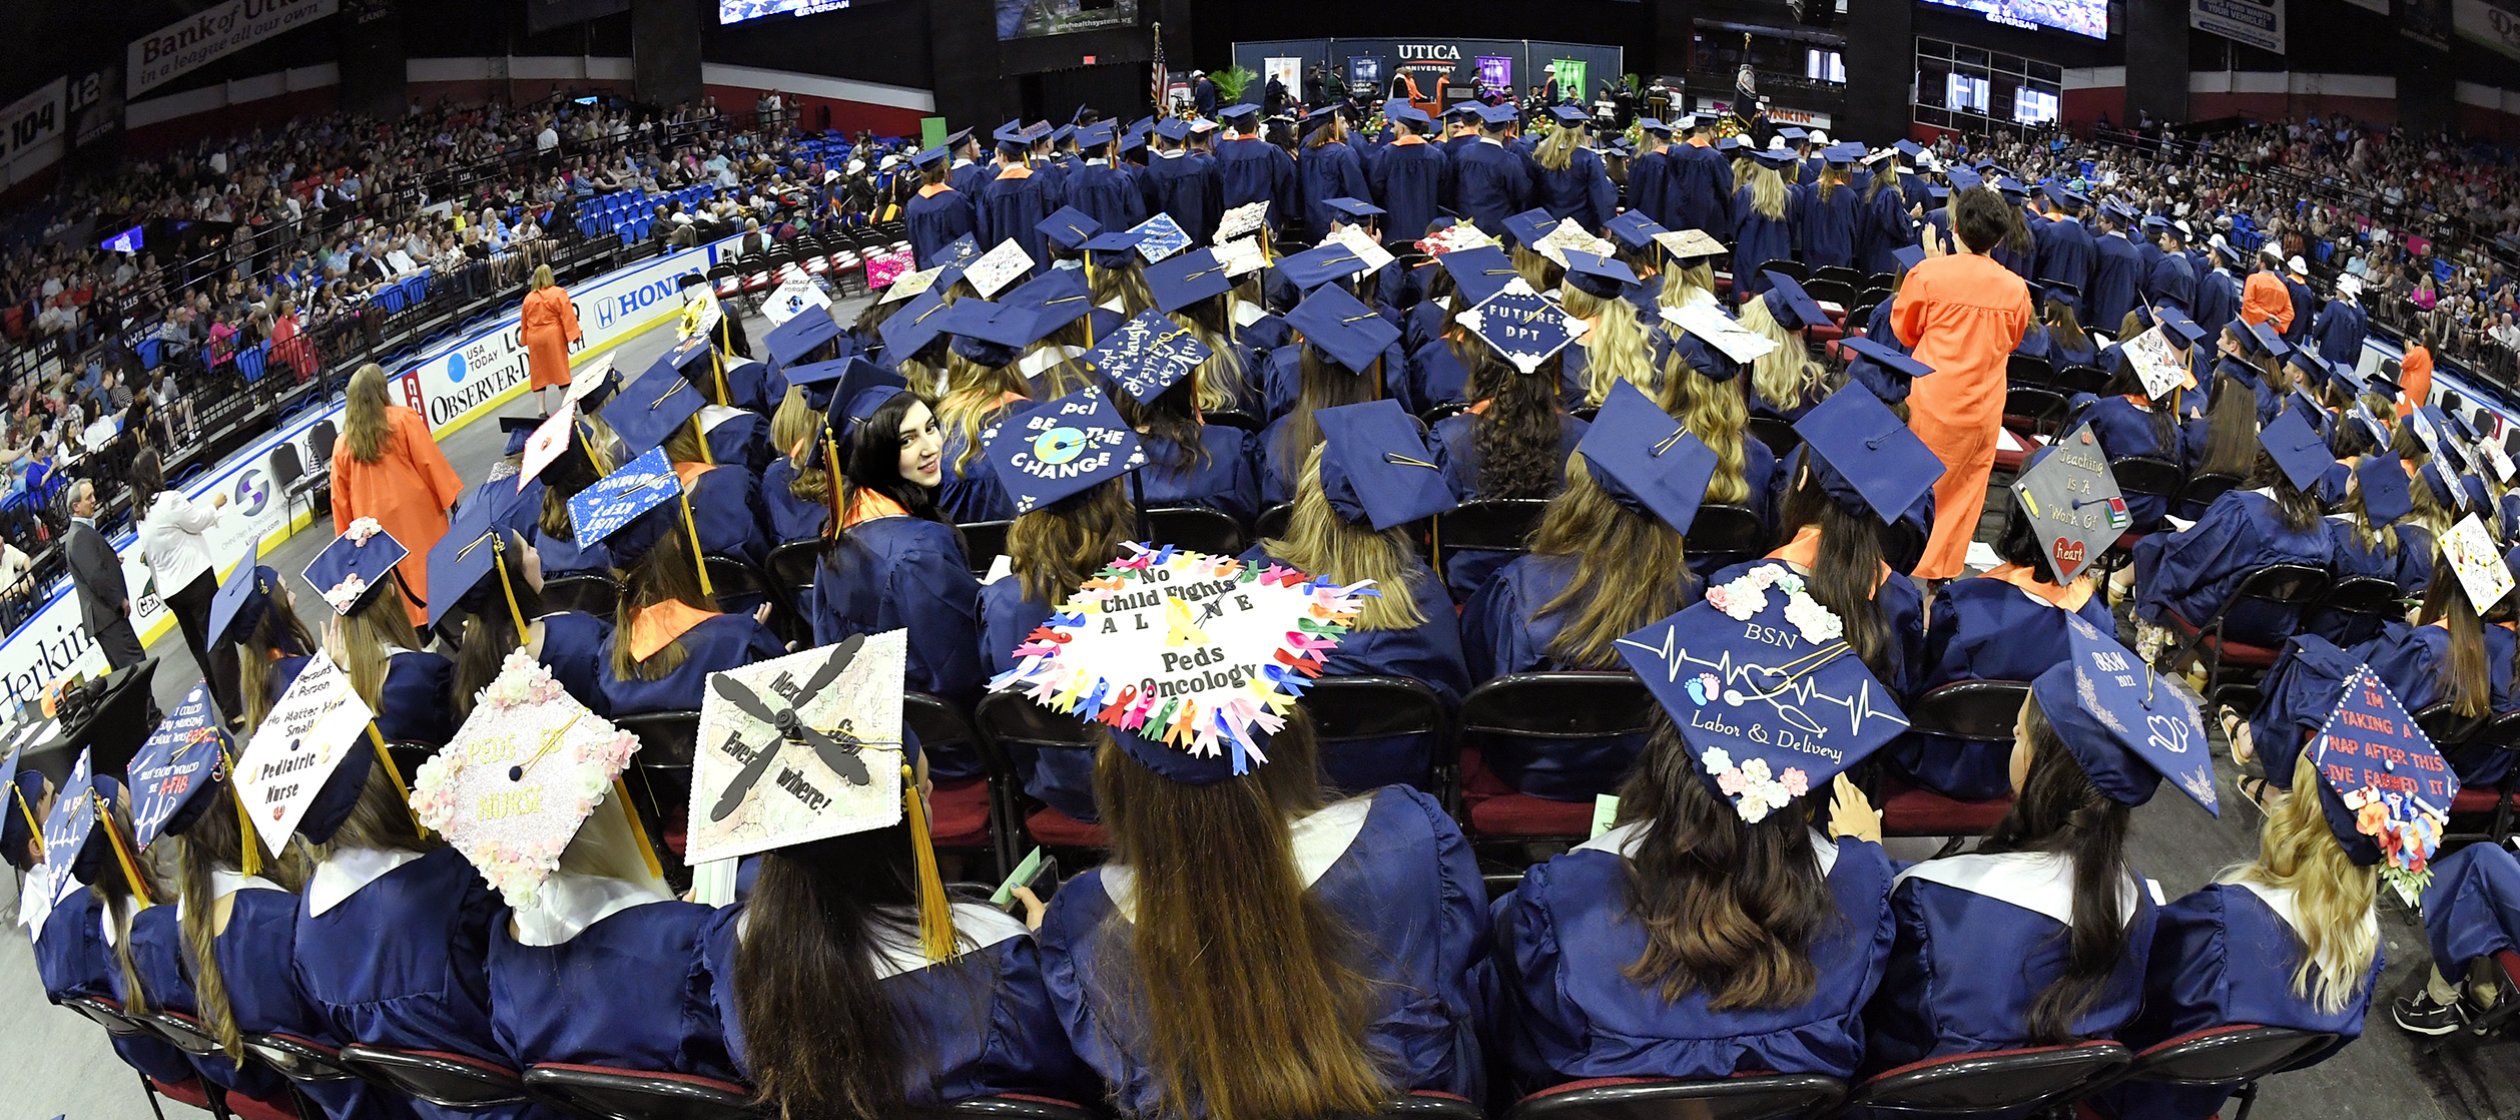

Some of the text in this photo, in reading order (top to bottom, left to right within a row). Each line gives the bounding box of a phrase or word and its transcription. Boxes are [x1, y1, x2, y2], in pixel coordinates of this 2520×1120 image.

[141, 4, 318, 84] in a league all our own
[143, 15, 217, 65] Bank
[218, 4, 241, 33] of
[1398, 45, 1461, 60] UTICA
[12, 101, 54, 151] 104
[123, 295, 139, 311] 115
[1489, 305, 1555, 324] FUTURE
[1506, 325, 1540, 341] DPT
[466, 345, 485, 359] USA
[469, 350, 499, 371] TODAY
[1026, 416, 1125, 445] BE THE
[1011, 452, 1111, 480] CHANGE
[2060, 447, 2104, 477] Teaching
[2048, 504, 2079, 528] Work
[1139, 568, 1170, 584] No
[1101, 579, 1236, 613] Child Fights
[1744, 623, 1798, 650] BSN
[1161, 646, 1225, 673] Peds
[2091, 651, 2130, 673] BSN
[287, 680, 331, 701] A Person
[769, 670, 803, 702] Nex
[1140, 663, 1257, 698] Oncology
[2114, 674, 2137, 688] 2022
[267, 699, 347, 727] No Matter How
[2339, 708, 2413, 740] TAKING A
[285, 719, 316, 738] Small
[1691, 709, 1843, 765] Labor & Delivery
[467, 731, 517, 767] PEDS
[720, 730, 762, 768] Ever
[2328, 734, 2445, 773] NAP AFTER THIS
[261, 752, 317, 781] Pediatric
[265, 783, 300, 804] Nurse
[776, 766, 833, 816] where!
[2363, 768, 2420, 794] EARNED
[2428, 779, 2444, 796] IT
[477, 785, 544, 822] NURSE
